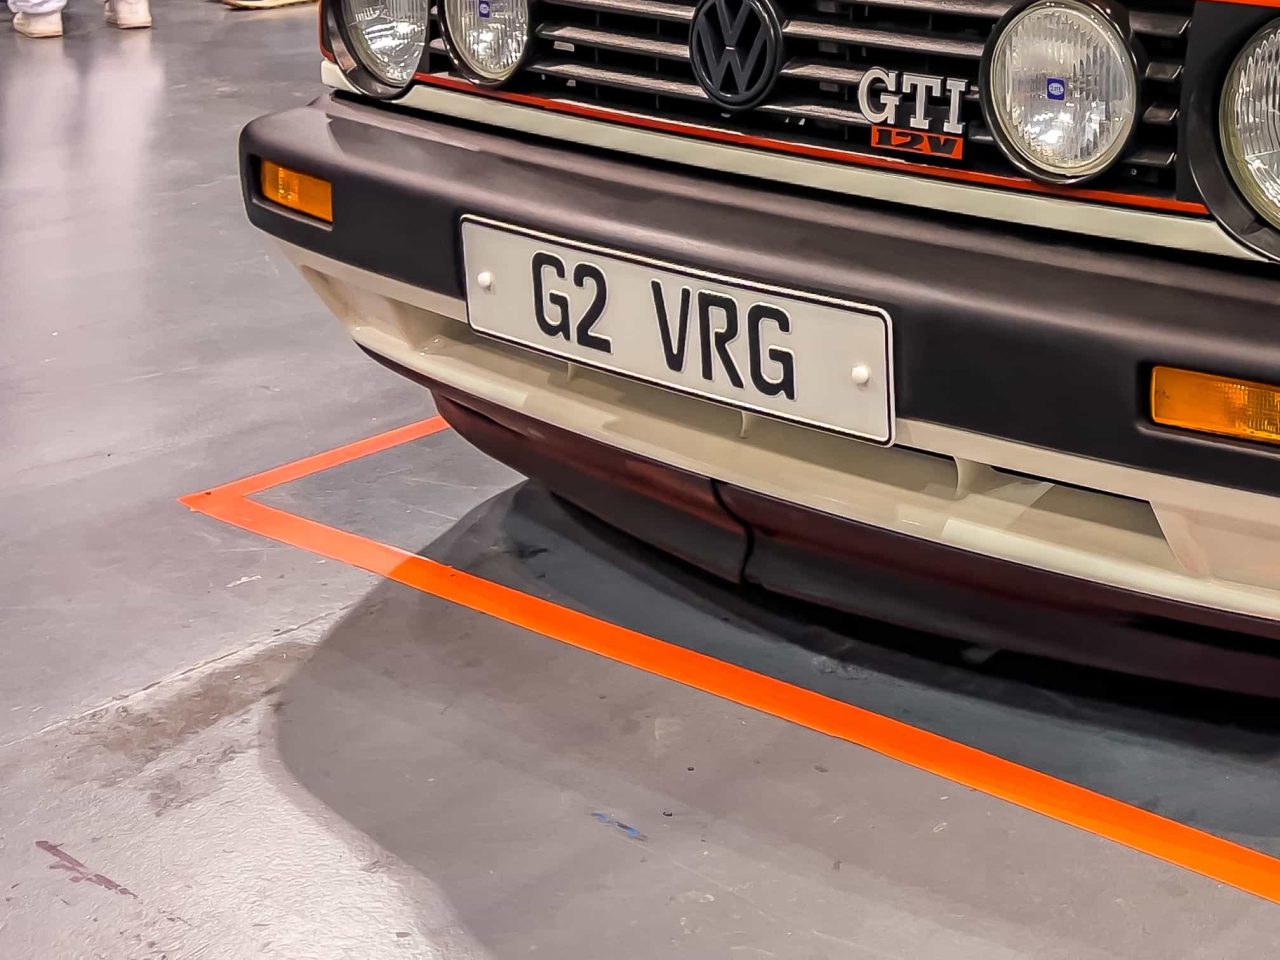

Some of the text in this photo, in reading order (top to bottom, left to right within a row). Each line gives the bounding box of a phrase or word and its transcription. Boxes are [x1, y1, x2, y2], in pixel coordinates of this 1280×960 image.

[858, 66, 969, 135] GTI
[874, 128, 958, 157] 12V
[530, 250, 795, 400] G2 VRG
